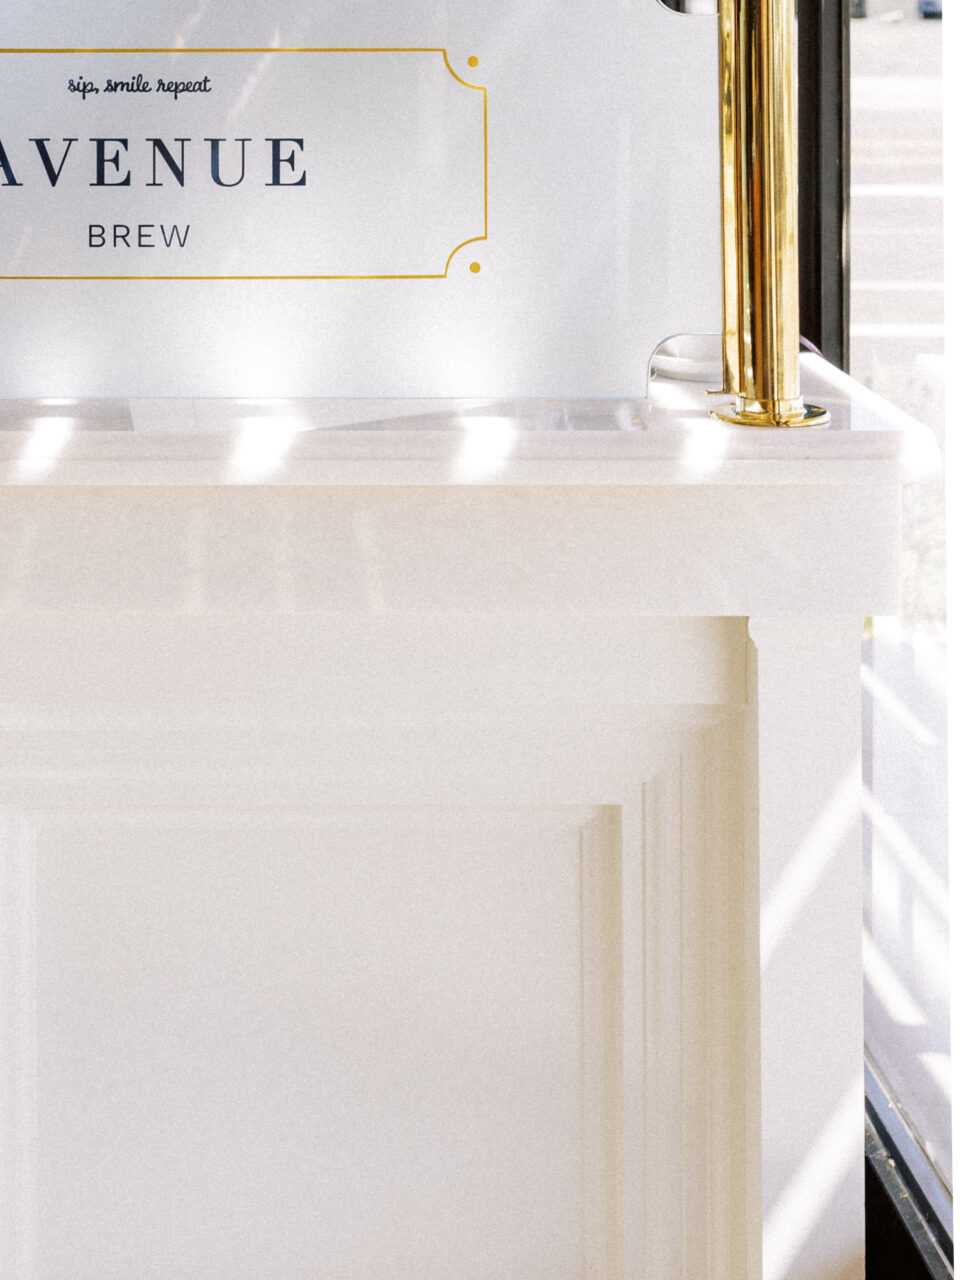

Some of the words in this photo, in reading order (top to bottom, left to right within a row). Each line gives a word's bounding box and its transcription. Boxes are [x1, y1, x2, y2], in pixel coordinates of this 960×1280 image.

[68, 75, 99, 99] sip,
[103, 73, 151, 95] smile
[156, 75, 211, 100] repeat
[88, 225, 191, 248] BREW
